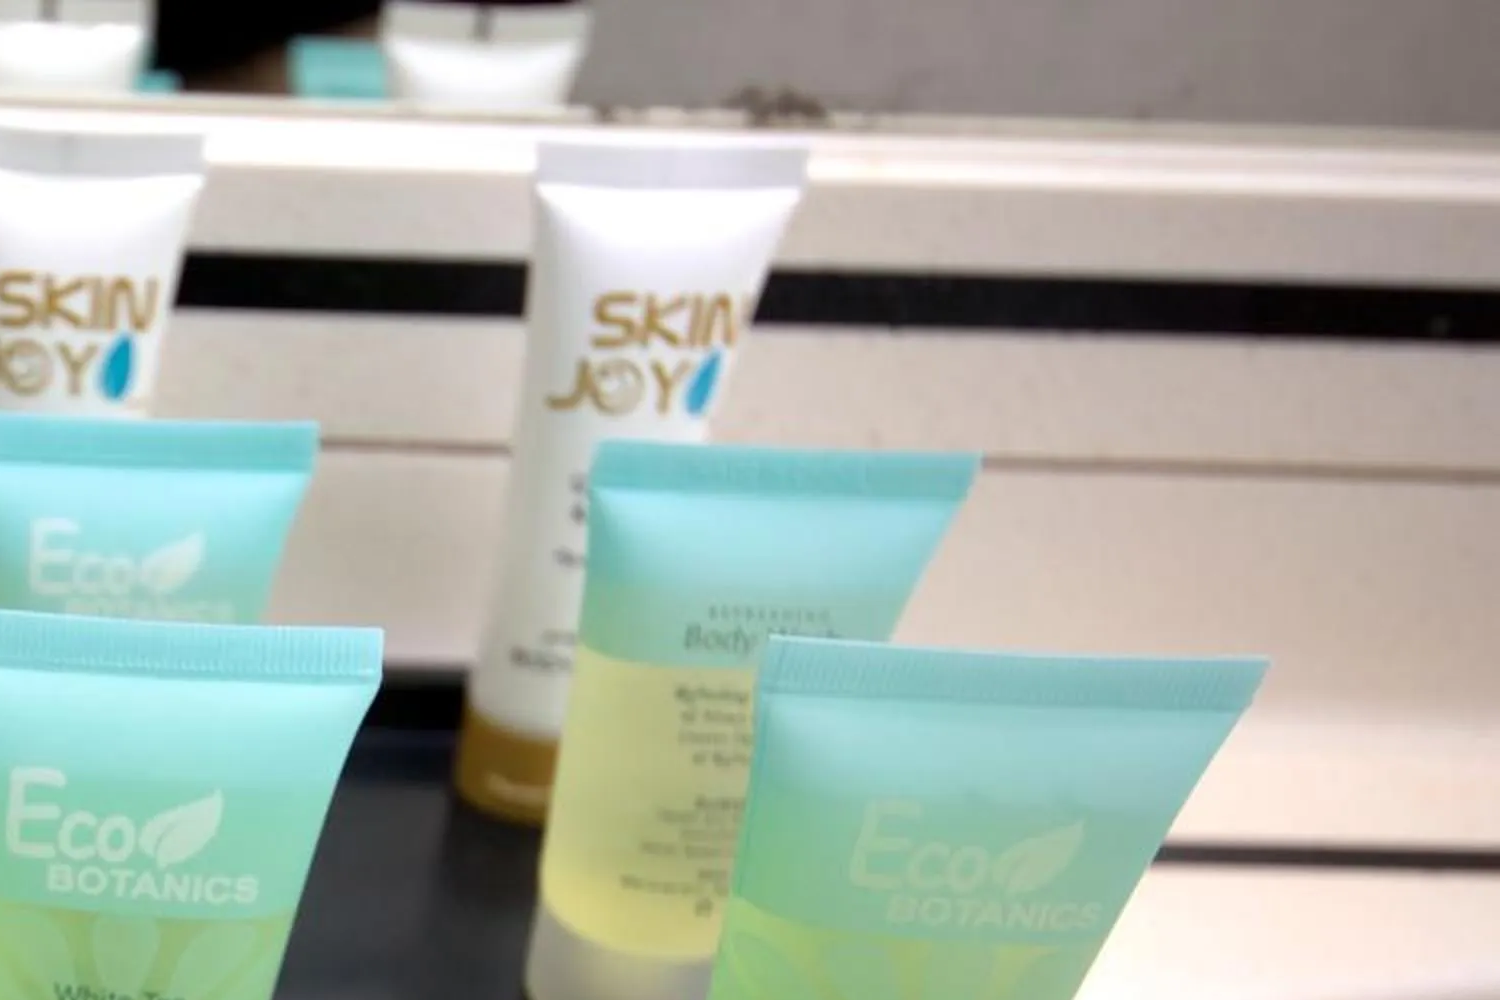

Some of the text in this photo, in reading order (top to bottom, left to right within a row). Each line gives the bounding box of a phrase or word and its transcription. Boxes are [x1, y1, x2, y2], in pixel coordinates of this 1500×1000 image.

[545, 360, 689, 416] JOY
[684, 623, 753, 656] Body
[7, 767, 136, 862] Eco
[850, 799, 989, 894] Eco
[46, 864, 259, 904] BOTANICS
[886, 895, 1101, 933] BOTANICS
